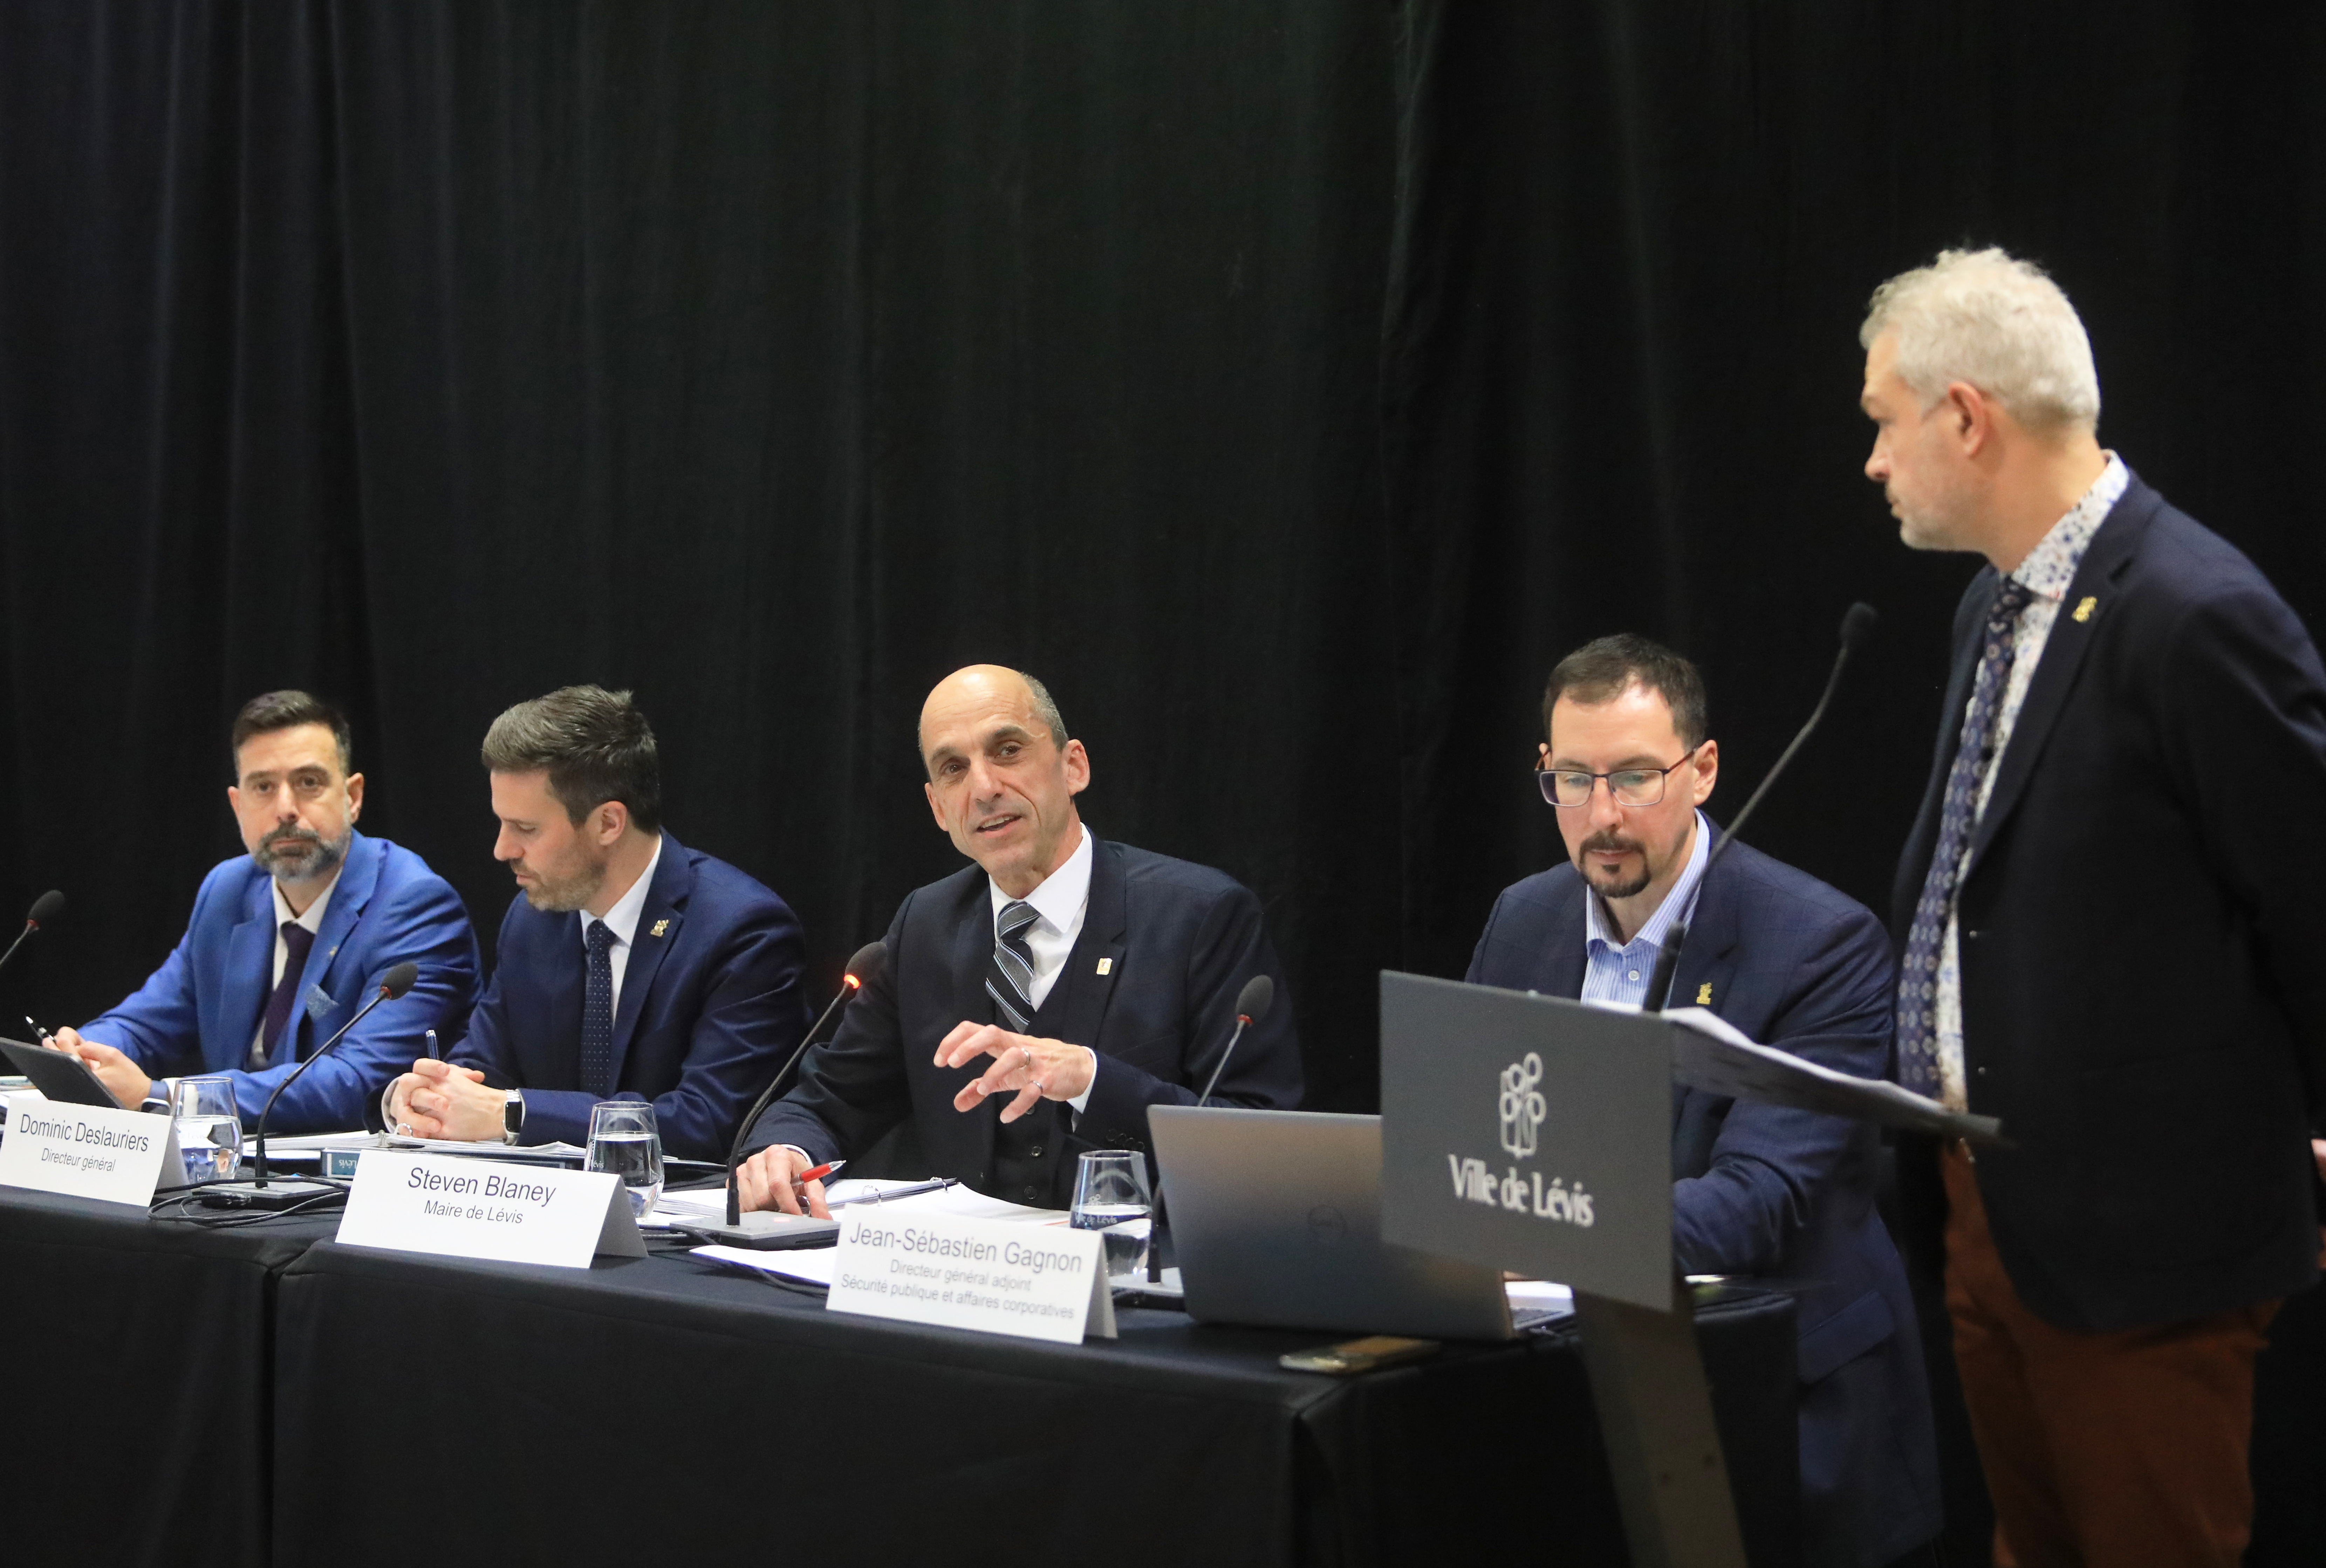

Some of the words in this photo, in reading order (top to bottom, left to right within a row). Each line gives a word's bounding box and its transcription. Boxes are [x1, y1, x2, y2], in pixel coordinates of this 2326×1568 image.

[20, 1114, 72, 1140] Dominic
[75, 1122, 149, 1151] Deslauriers
[42, 1148, 81, 1166] Directeur
[81, 1155, 116, 1171] général
[338, 1159, 357, 1169] Lévis
[408, 1167, 478, 1194] Steven
[485, 1175, 556, 1207] Blaney
[1448, 1154, 1498, 1206] Ville
[1500, 1166, 1529, 1213] de
[1531, 1171, 1594, 1227] Lévis
[424, 1200, 462, 1217] Maire
[466, 1205, 483, 1219] de
[487, 1207, 523, 1223] Lévis
[850, 1222, 997, 1261] Jean-Sébastien
[1005, 1242, 1081, 1273] Gagnon
[890, 1259, 941, 1278] Directeur
[944, 1268, 989, 1285] général
[992, 1274, 1031, 1292] adjoint
[841, 1274, 888, 1293] Sécurité
[890, 1282, 939, 1301] publique
[942, 1291, 953, 1302] et
[956, 1290, 1000, 1308] affaires
[1003, 1300, 1074, 1318] corporatives
